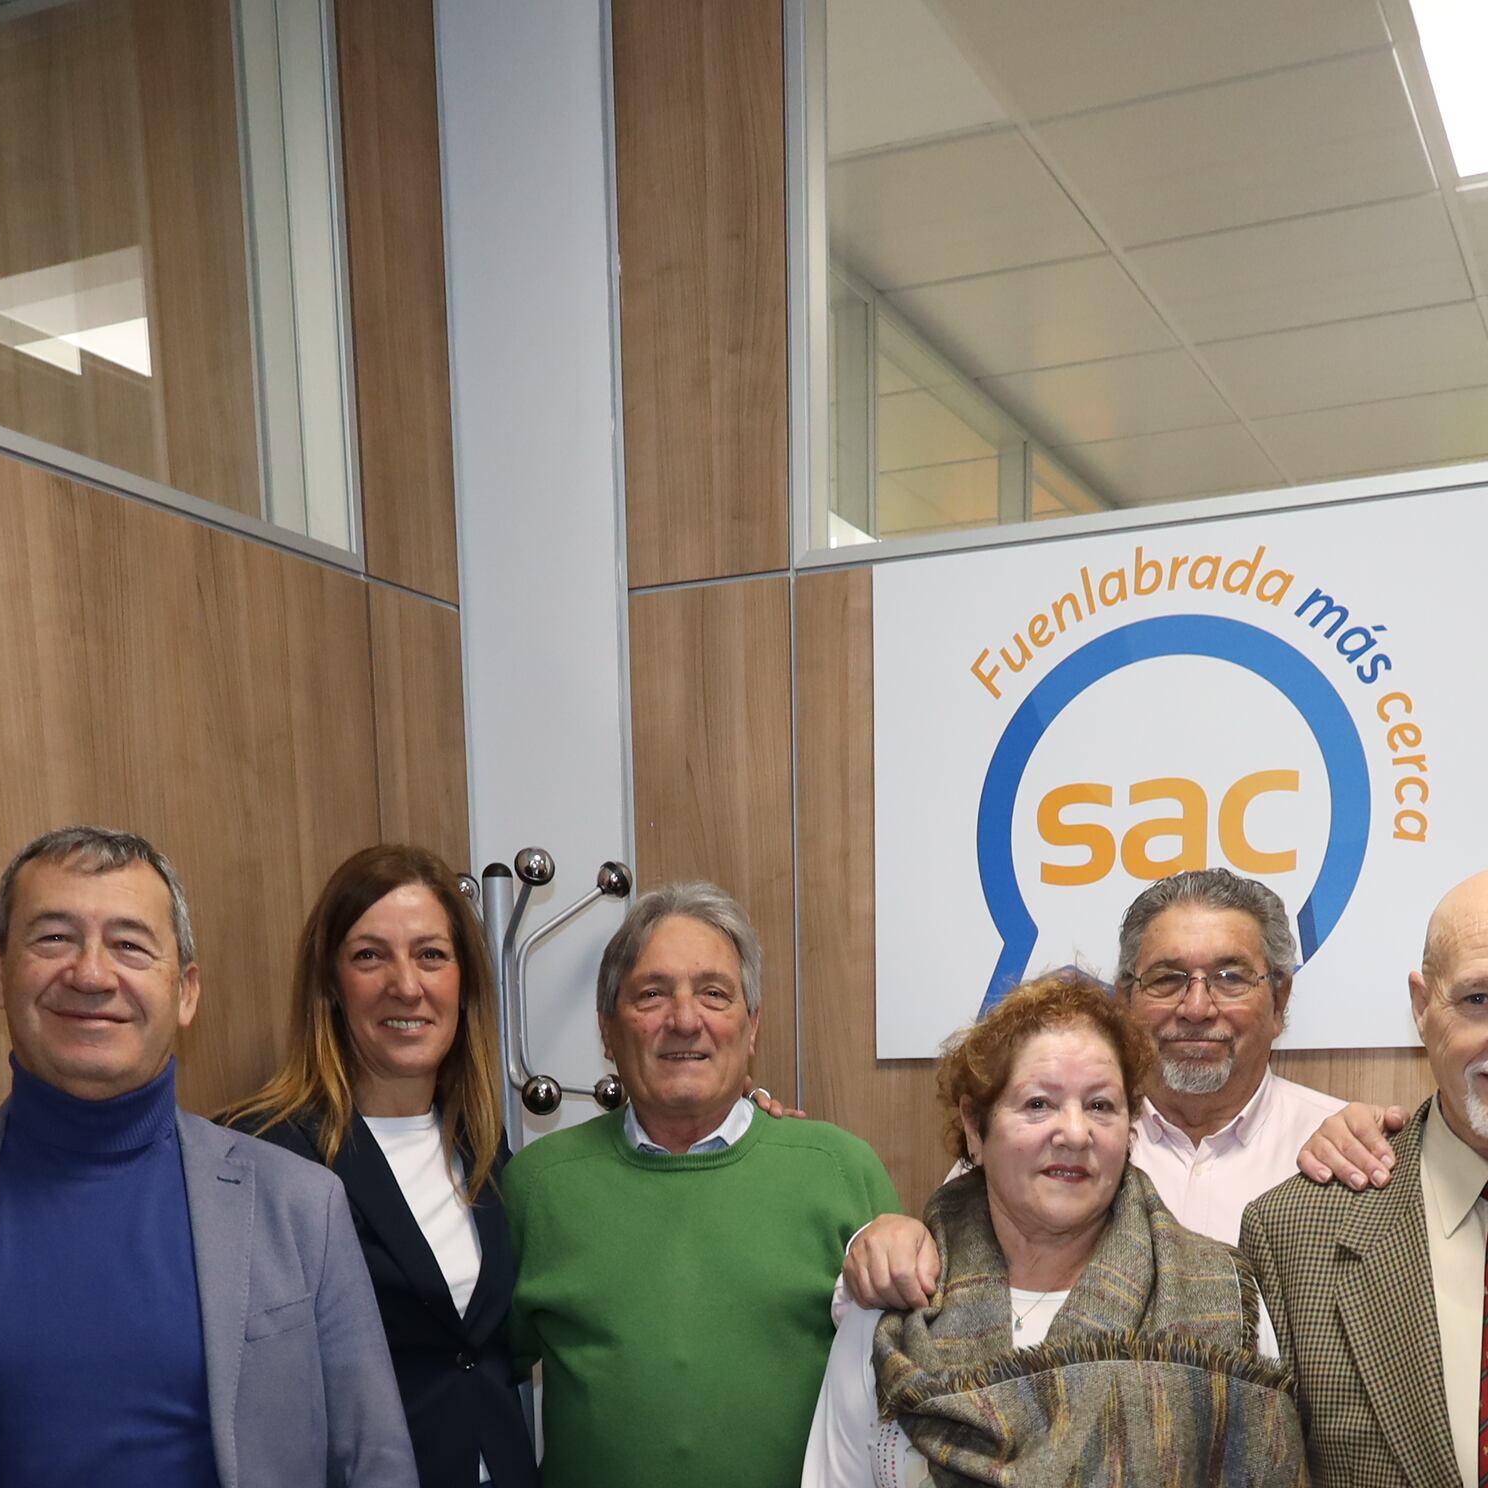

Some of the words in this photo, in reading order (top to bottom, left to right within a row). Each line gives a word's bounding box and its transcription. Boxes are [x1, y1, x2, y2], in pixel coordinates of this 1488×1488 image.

[971, 546, 1294, 699] Fuenlabrada
[1292, 586, 1392, 685] más
[1377, 691, 1429, 843] cerca
[1036, 769, 1300, 887] sac
